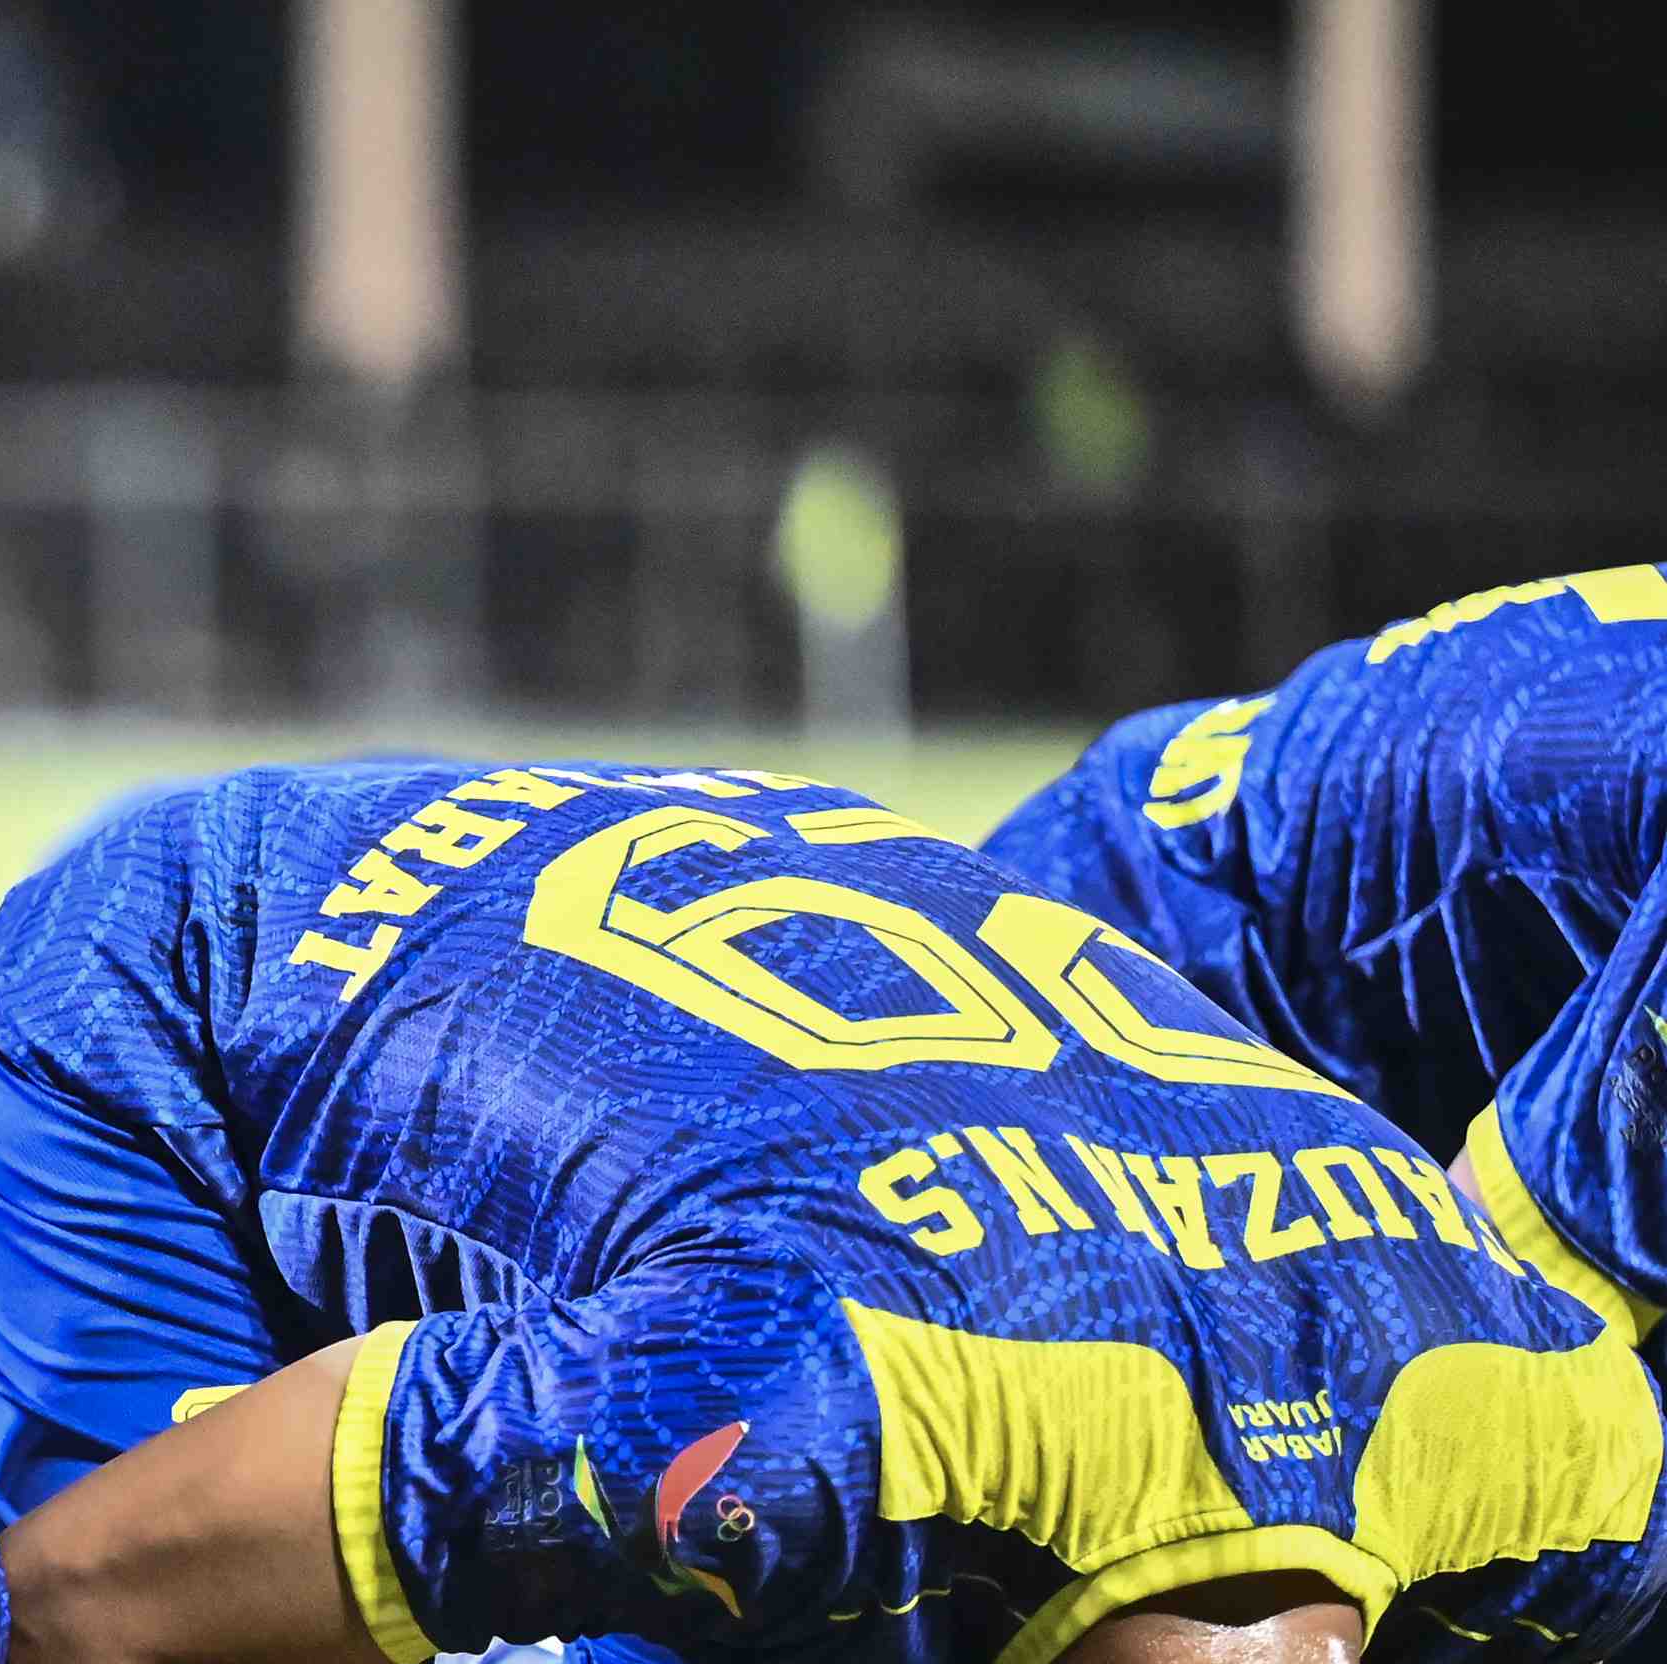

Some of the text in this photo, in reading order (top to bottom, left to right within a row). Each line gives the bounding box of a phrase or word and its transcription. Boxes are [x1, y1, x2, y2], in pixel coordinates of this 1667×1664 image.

[289, 766, 657, 1001] ARAT
[1062, 1136, 1527, 1280] AUZAN
[1227, 1389, 1333, 1429] JUARA
[1241, 1426, 1342, 1462] JABAR
